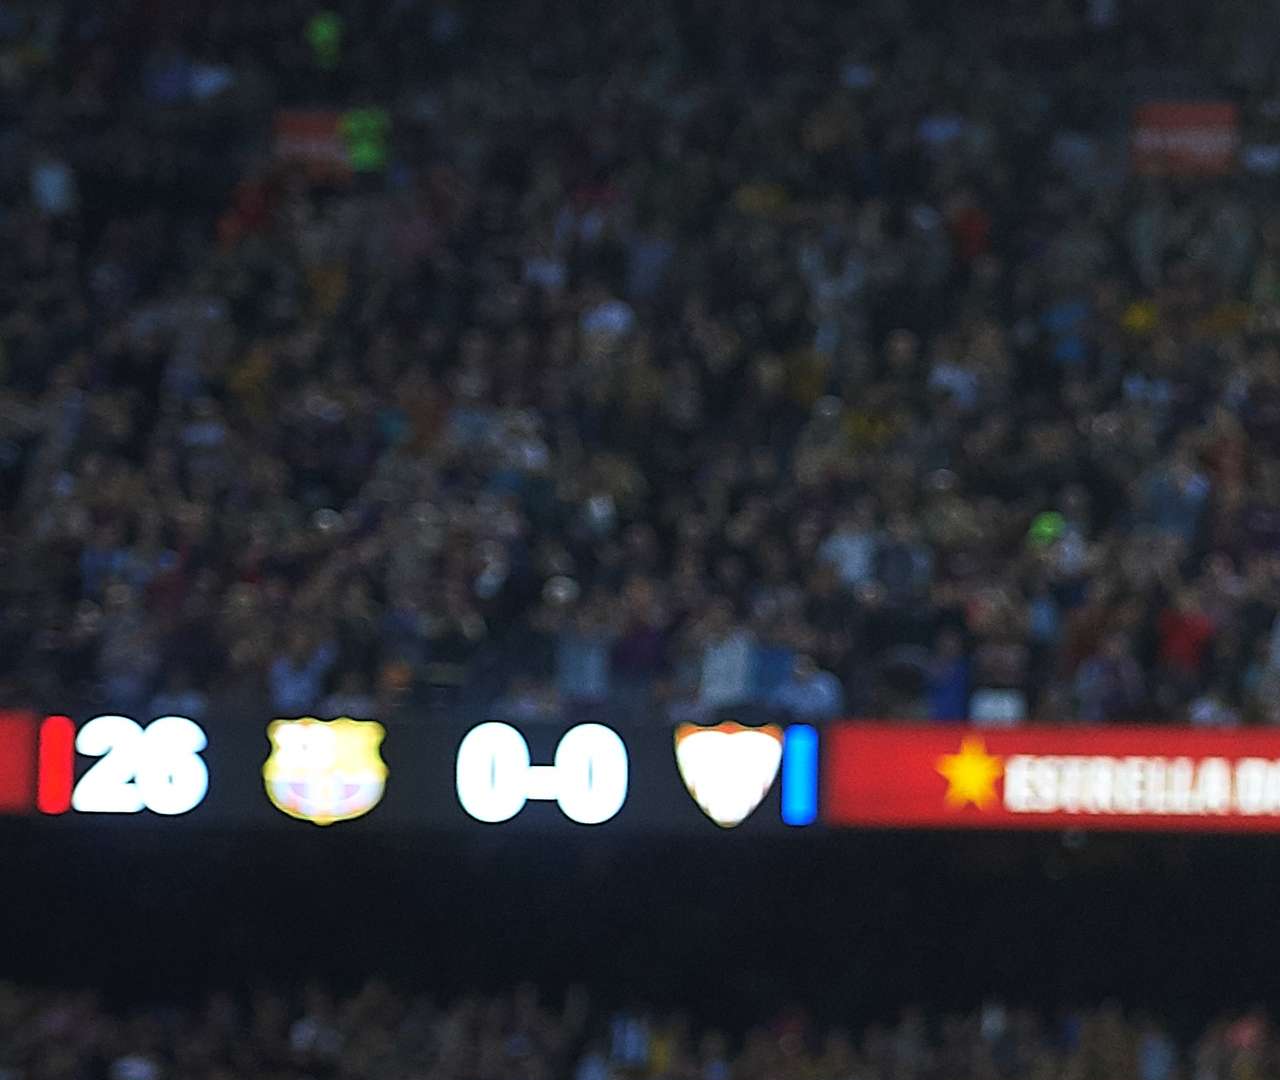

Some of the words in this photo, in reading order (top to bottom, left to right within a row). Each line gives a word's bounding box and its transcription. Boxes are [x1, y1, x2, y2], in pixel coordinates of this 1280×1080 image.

[71, 715, 208, 816] 26
[456, 721, 629, 824] 0-0
[1003, 754, 1230, 816] ESTRELLA
